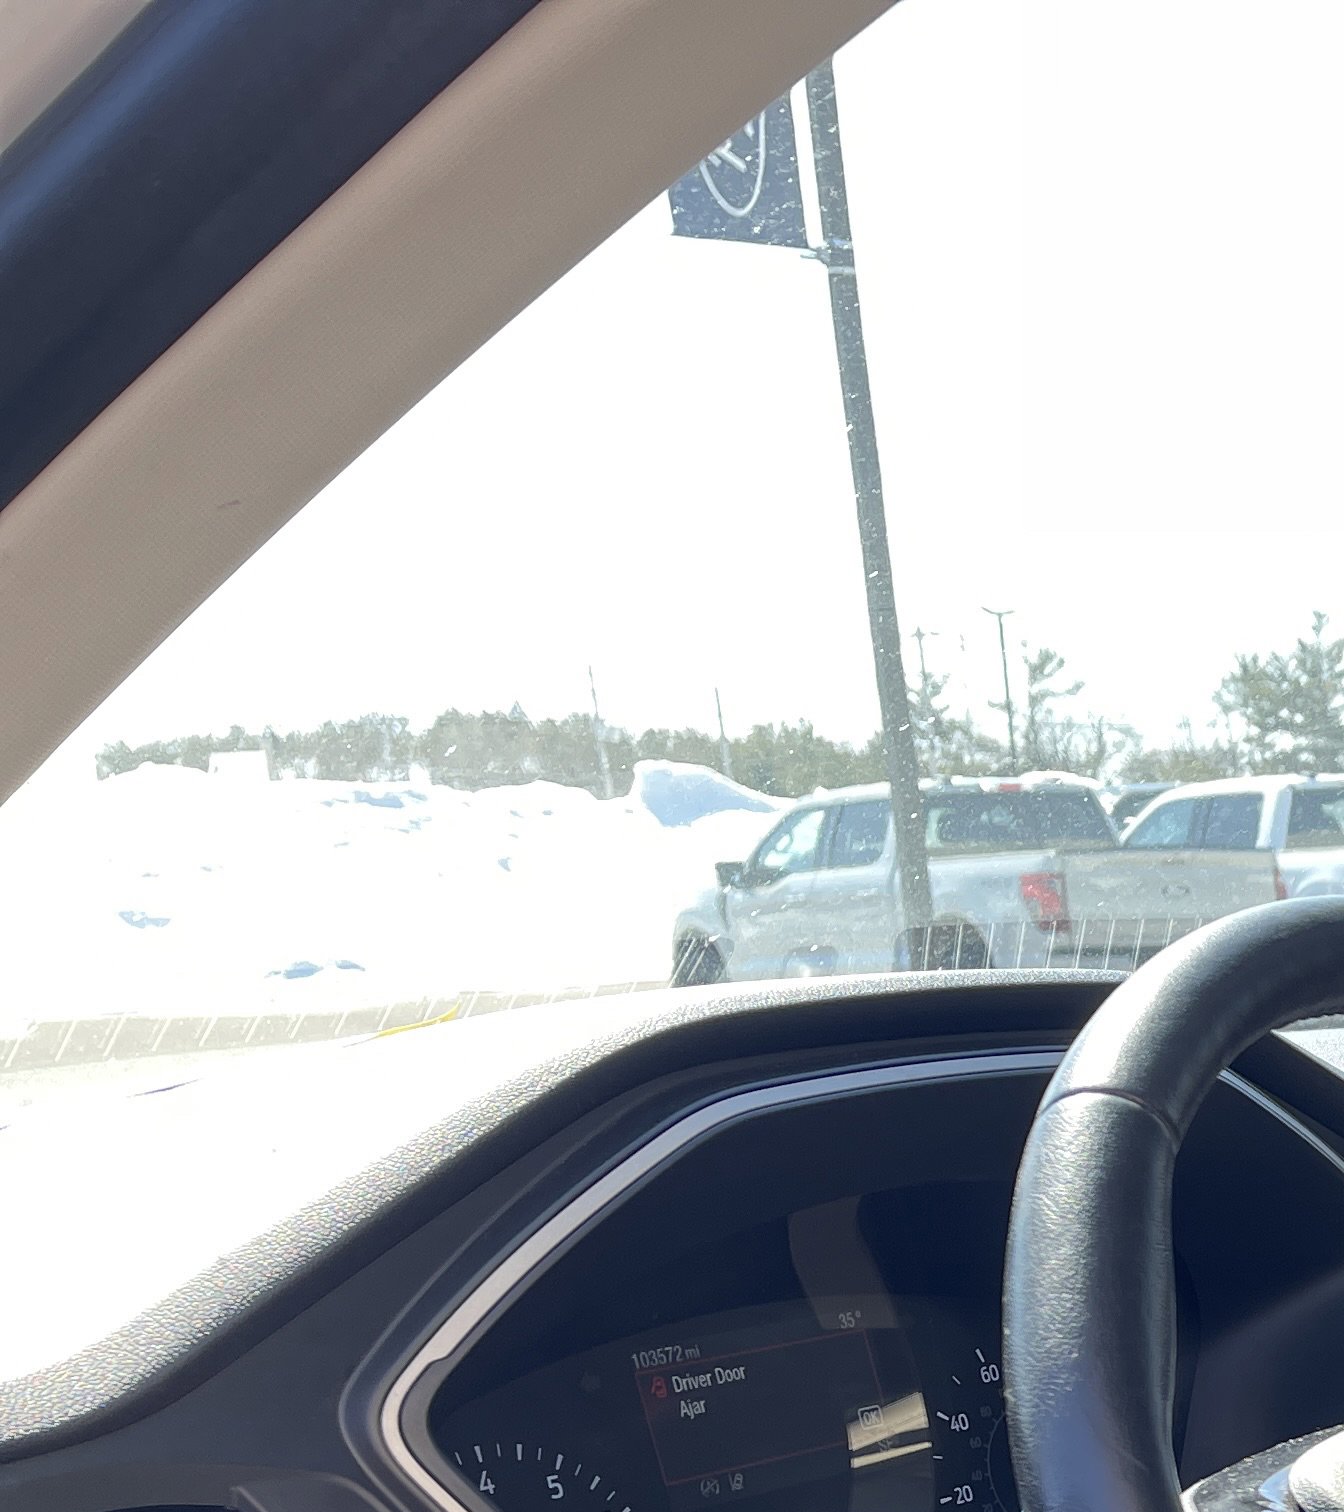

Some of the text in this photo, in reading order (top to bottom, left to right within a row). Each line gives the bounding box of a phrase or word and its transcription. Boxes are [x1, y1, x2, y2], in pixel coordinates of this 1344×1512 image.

[631, 1344, 683, 1370] 103572
[671, 1364, 747, 1394] Driver Door
[980, 1364, 1000, 1384] 60
[679, 1398, 706, 1420] Ajar
[863, 1409, 881, 1426] OK
[950, 1412, 969, 1432] 40
[479, 1470, 496, 1495] 4
[546, 1474, 564, 1499] 5
[953, 1484, 974, 1505] 20
